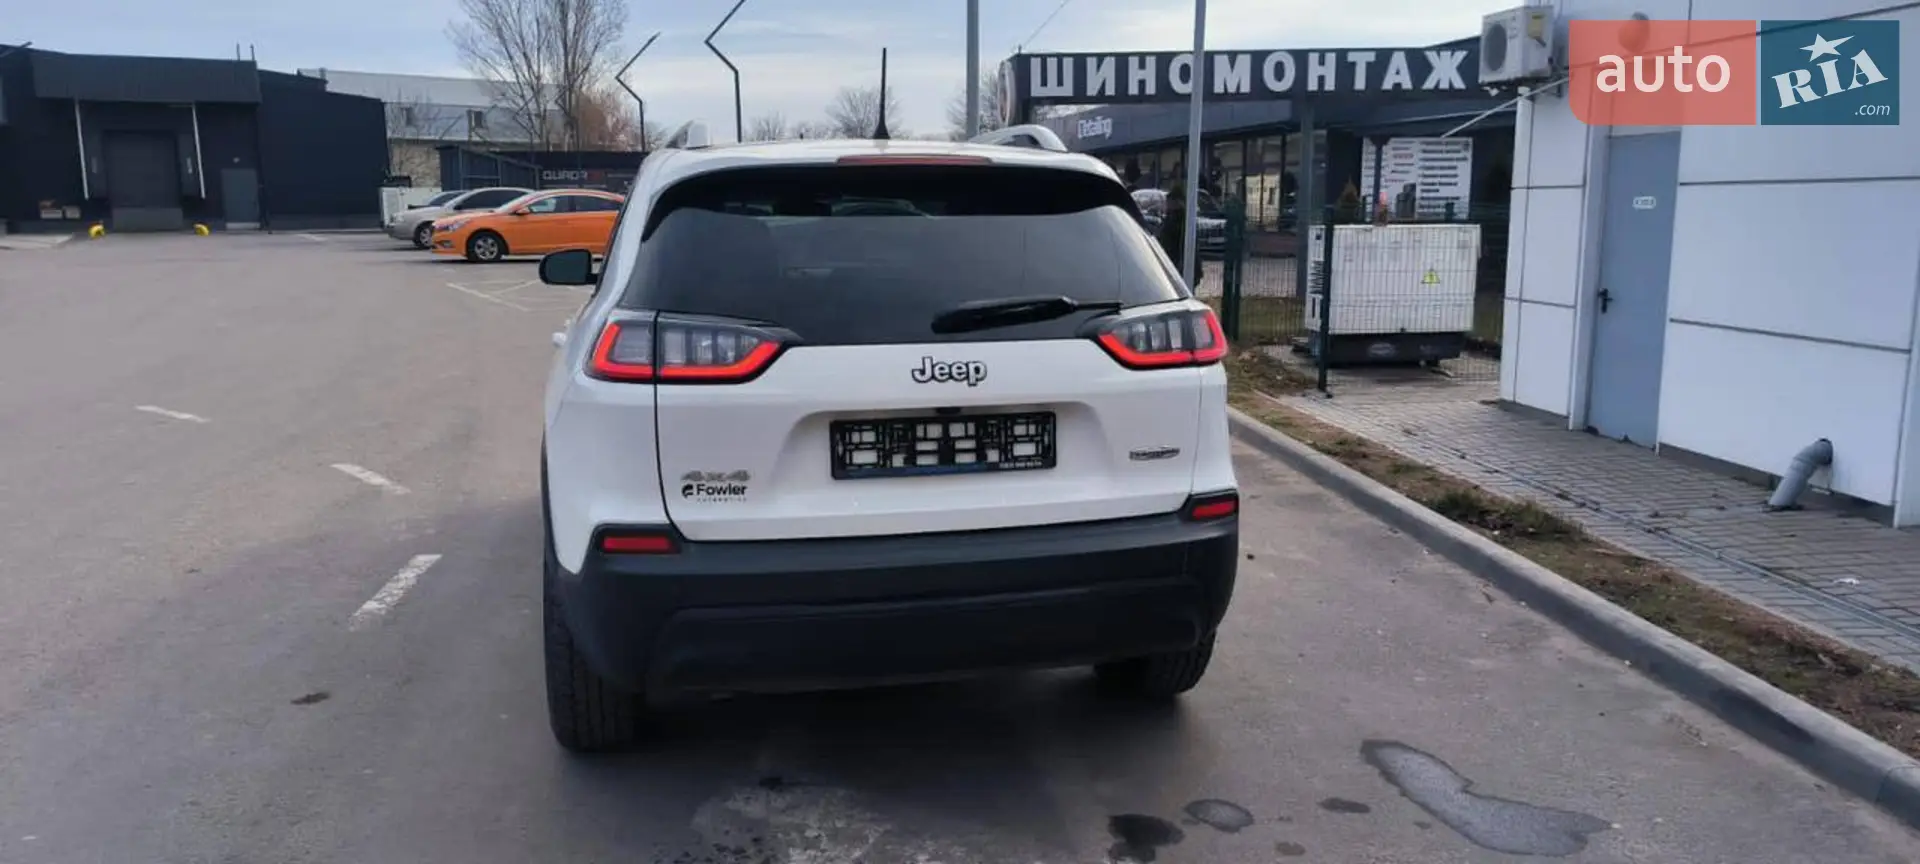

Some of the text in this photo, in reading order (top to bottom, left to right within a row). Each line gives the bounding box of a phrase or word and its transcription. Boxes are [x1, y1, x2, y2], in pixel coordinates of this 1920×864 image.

[1030, 50, 1468, 97] ШИНОМОНТАЖ
[911, 356, 987, 387] Jeep
[696, 483, 747, 496] Fowler
